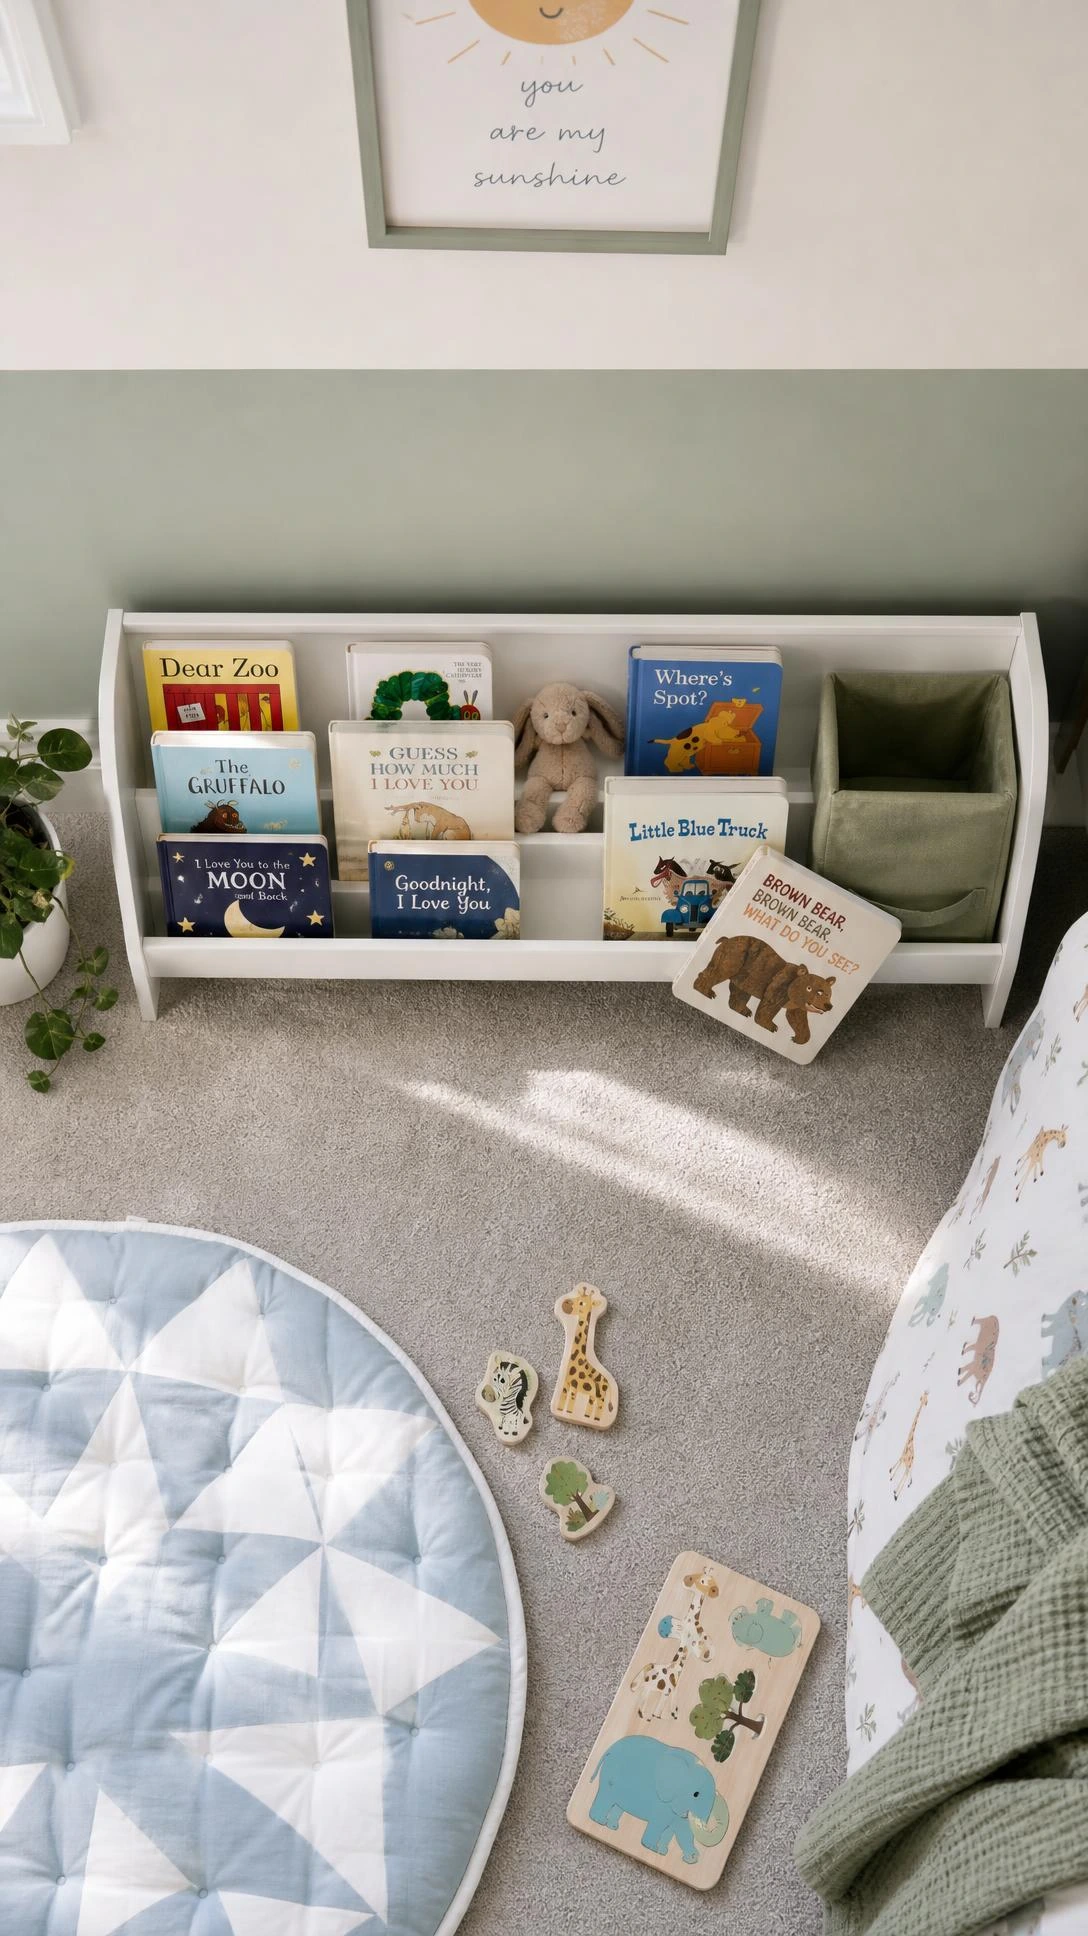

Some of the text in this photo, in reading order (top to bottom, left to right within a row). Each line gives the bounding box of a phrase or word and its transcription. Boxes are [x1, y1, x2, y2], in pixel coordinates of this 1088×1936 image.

[521, 80, 584, 108] you
[490, 125, 605, 154] are my
[473, 162, 626, 188] sunshine
[159, 657, 279, 678] Dear Zoo
[654, 669, 732, 686] Where's
[653, 689, 708, 709] Spot?
[389, 747, 458, 760] GUESS
[215, 759, 249, 774] The
[371, 763, 479, 776] HOW MUCH
[188, 776, 285, 795] GRUFFALO
[371, 779, 479, 791] I LOVE YOU
[628, 818, 768, 842] Little Blue Truck
[204, 858, 231, 869] Love
[233, 858, 254, 869] You
[258, 861, 269, 869] to
[273, 860, 290, 870] the
[207, 871, 286, 890] MOON
[395, 874, 491, 896] Goodnight,
[397, 894, 491, 915] I Love You
[762, 873, 847, 932] BROWN BEAR,
[752, 889, 831, 944] BROWN BEAR,
[743, 903, 860, 976] WHAT DO YOU SEE?
